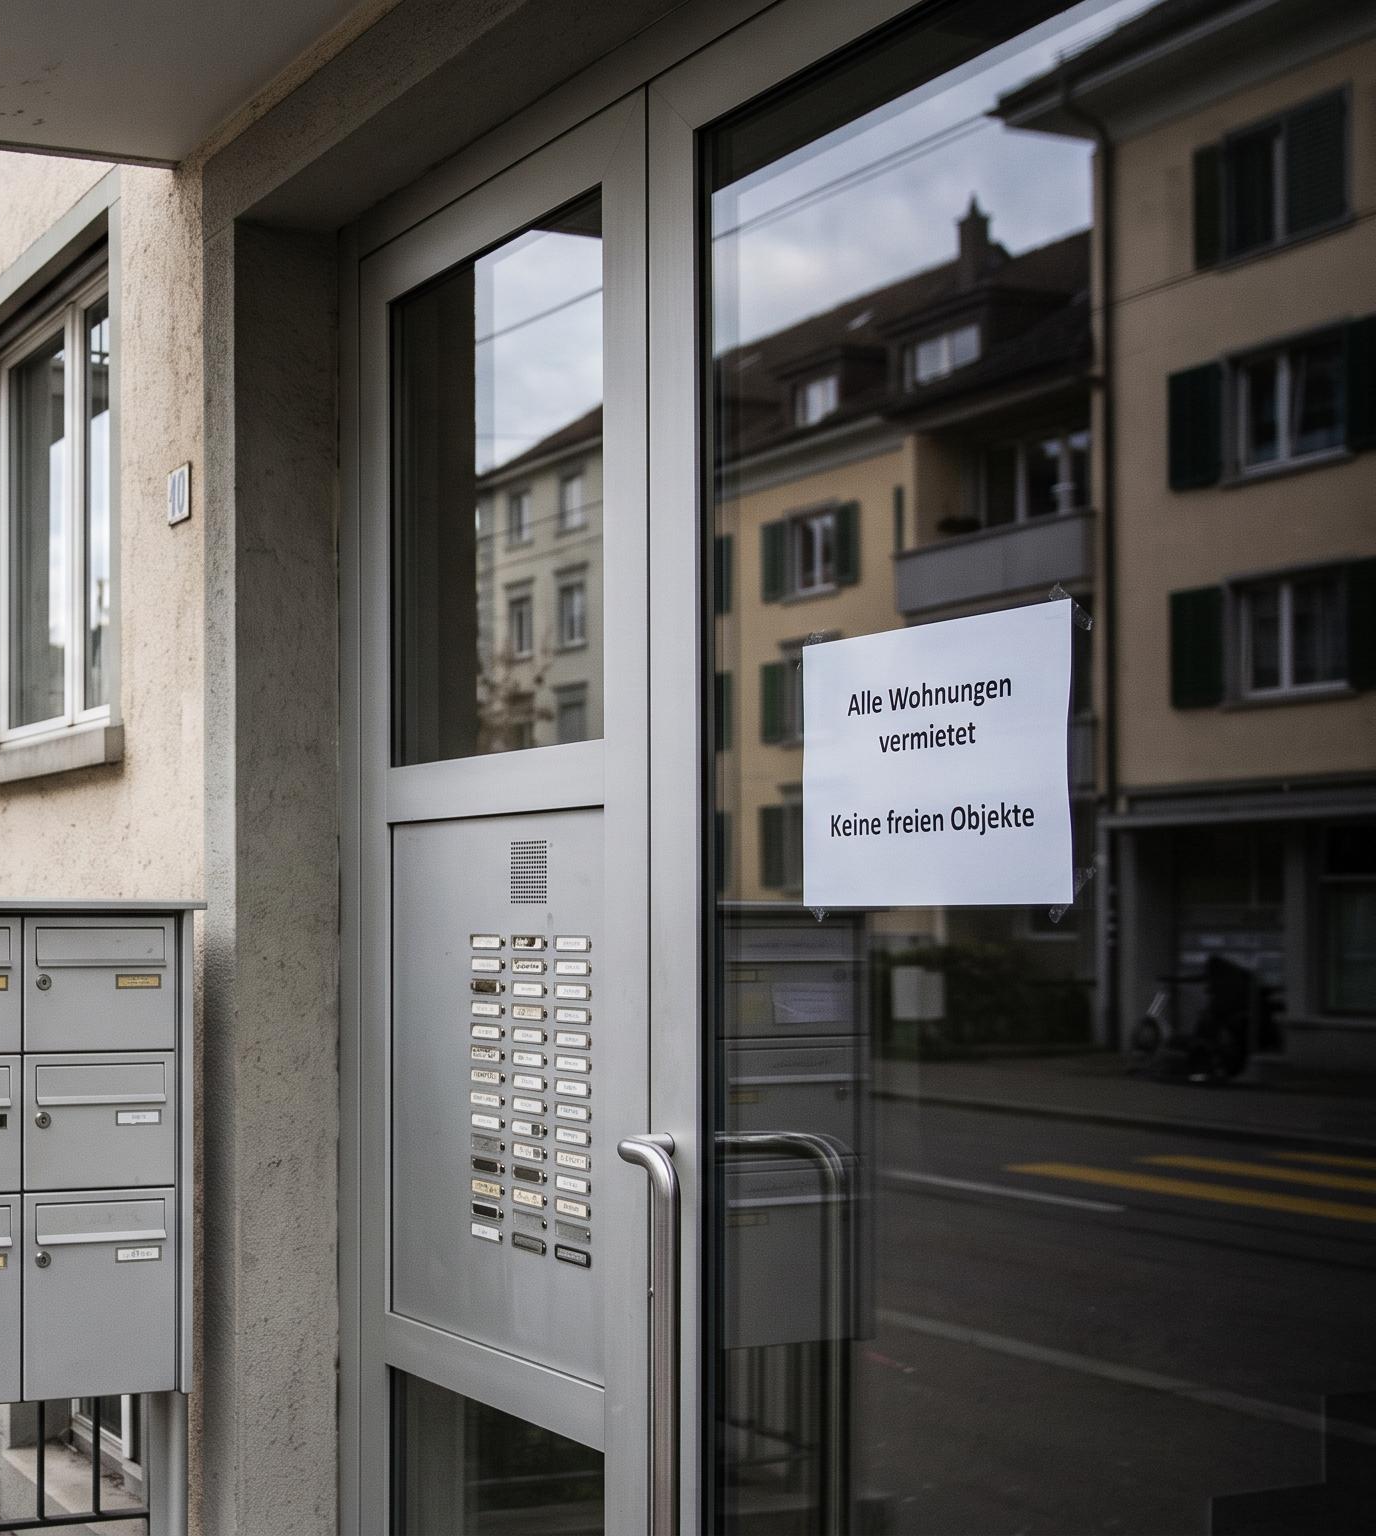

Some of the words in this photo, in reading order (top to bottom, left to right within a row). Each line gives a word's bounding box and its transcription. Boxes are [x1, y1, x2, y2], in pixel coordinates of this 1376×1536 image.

[169, 469, 186, 517] 10
[847, 691, 883, 717] Alle
[888, 677, 1013, 711] Wohnungen
[879, 721, 976, 753] vermietet
[830, 813, 882, 837] Keine
[887, 808, 944, 834] freien
[950, 802, 1035, 836] Objekte
